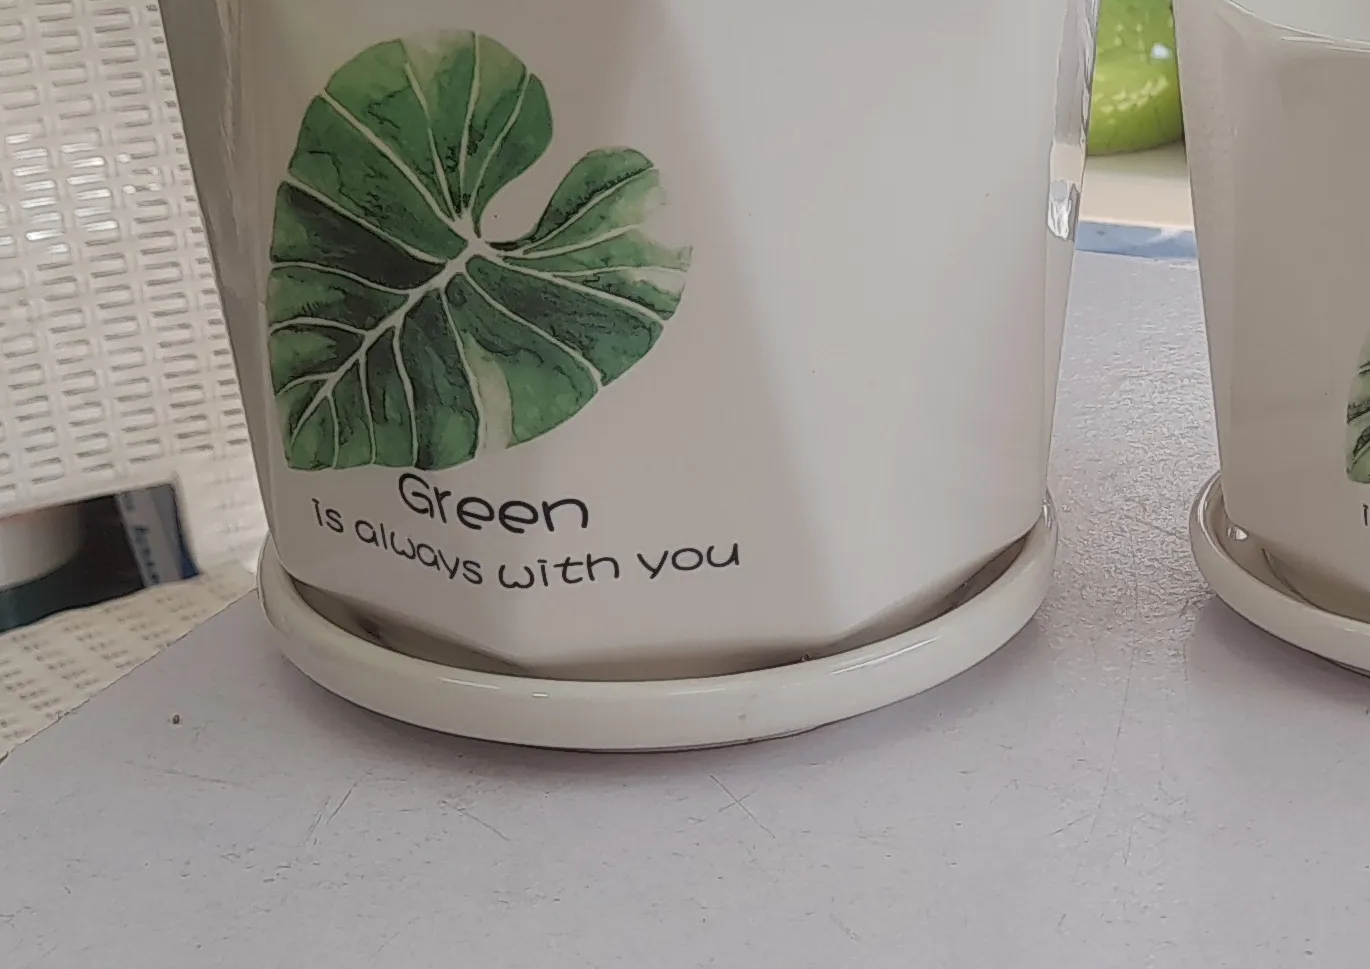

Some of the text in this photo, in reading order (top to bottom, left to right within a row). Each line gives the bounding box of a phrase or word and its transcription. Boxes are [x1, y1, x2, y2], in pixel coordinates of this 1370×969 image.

[399, 472, 589, 534] Green
[354, 519, 484, 585] always
[498, 553, 620, 589] with
[637, 543, 739, 580] you
